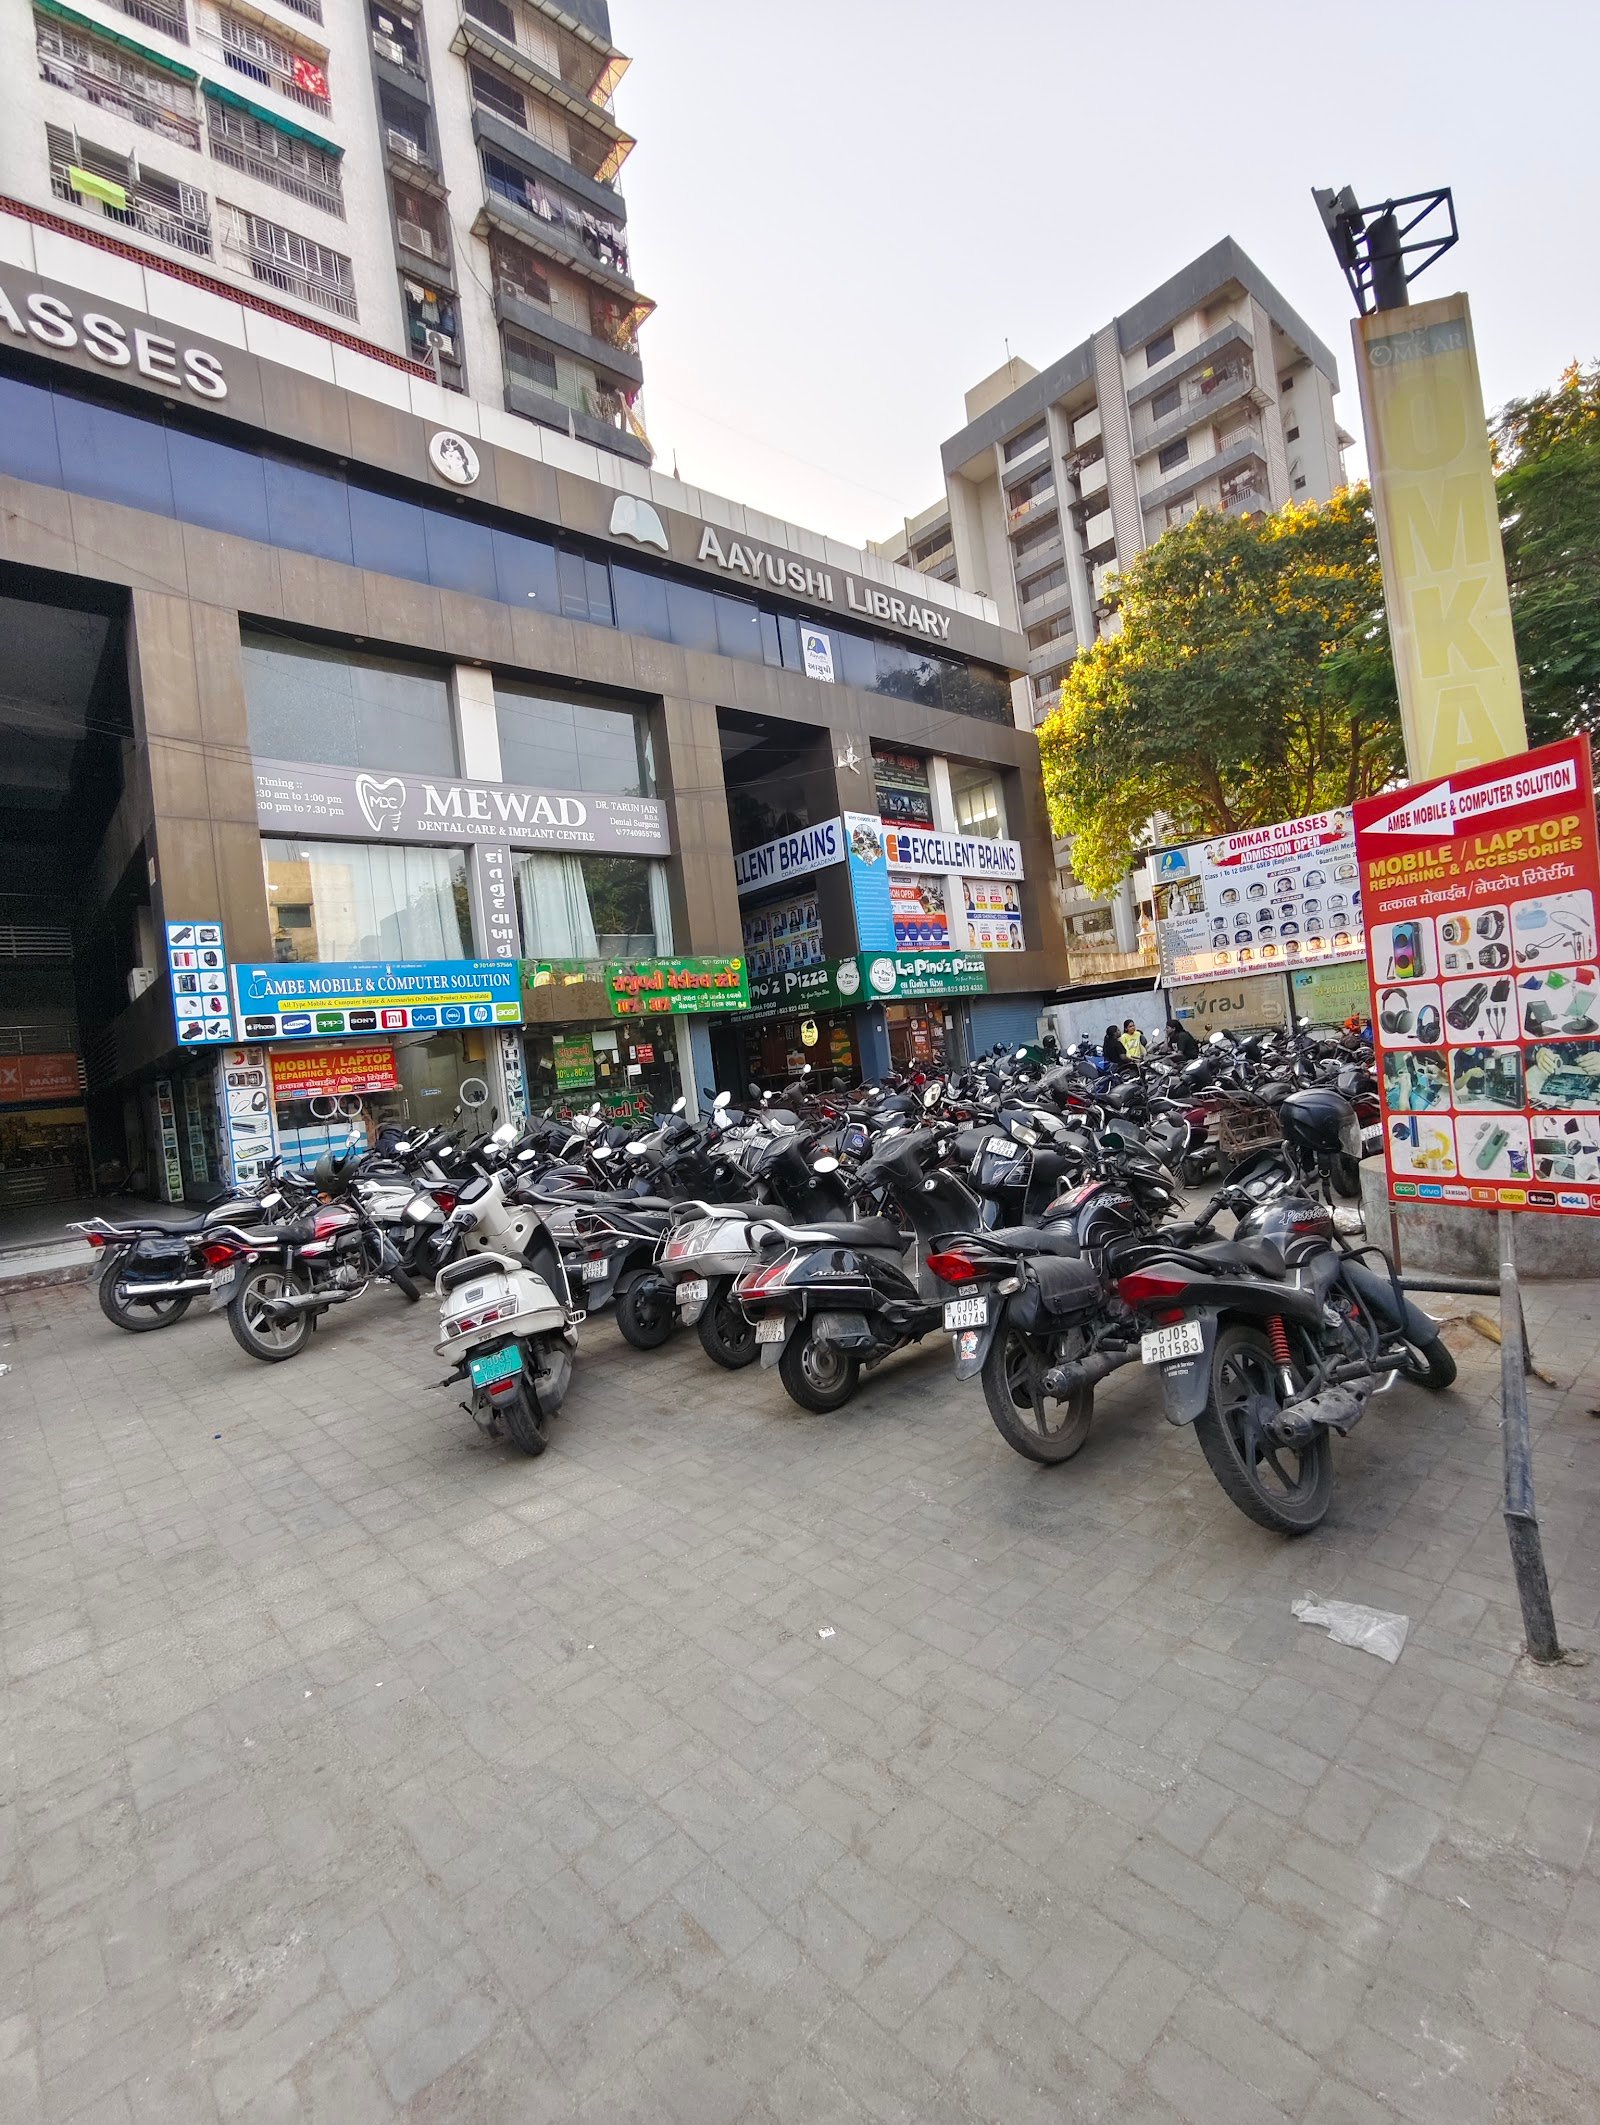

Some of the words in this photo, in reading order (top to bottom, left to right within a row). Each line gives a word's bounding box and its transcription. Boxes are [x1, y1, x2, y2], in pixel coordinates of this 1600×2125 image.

[845, 576, 950, 639] LIBRARY
[257, 776, 294, 790] Timing
[274, 792, 289, 800] am
[292, 792, 301, 800] to
[305, 793, 325, 802] 1:00
[327, 796, 342, 804] pm
[370, 796, 397, 809] MDC
[422, 784, 587, 827] MEWAD
[1387, 813, 1412, 832] AMBE
[1412, 801, 1447, 824] MOBILE
[1449, 800, 1457, 816] &
[1459, 783, 1514, 812] COMPUTER
[1515, 767, 1571, 796] SOLUTION
[276, 803, 292, 812] pm
[294, 805, 304, 813] to
[329, 808, 344, 816] pm
[610, 802, 640, 812] TARUN
[641, 805, 658, 814] JAIN
[417, 821, 464, 833] DENTAL
[467, 824, 497, 835] CARE
[499, 827, 506, 836] &
[509, 827, 555, 839] IMPLANT
[556, 830, 595, 842] CENTRE
[610, 817, 632, 827] Dental
[634, 820, 660, 829] Surgeon
[1229, 831, 1270, 851] OMKAR
[1274, 815, 1328, 840] CLASSES
[778, 825, 836, 871] BRAINS
[912, 838, 975, 868] EXCELLENT
[978, 844, 1016, 871] BRAINS
[1240, 843, 1291, 864] ADMISSION
[1294, 835, 1321, 852] OPEN
[1369, 845, 1452, 879] MOBILE
[1475, 815, 1581, 856] LAPTOP
[781, 865, 808, 878] COACHING
[809, 856, 837, 870] ACADEMY
[1205, 872, 1219, 881] Class
[1256, 861, 1271, 869] GSEB
[1315, 845, 1339, 856] Gujarati
[1319, 857, 1333, 865] Board
[1334, 854, 1351, 862] Results
[1369, 866, 1445, 892] REPAIRING
[1449, 863, 1460, 875] &
[1465, 836, 1583, 873] ACCESSORIES
[901, 889, 915, 899] OPEN
[1166, 921, 1175, 929] Our
[1176, 917, 1198, 927] Services
[895, 959, 914, 976] La
[952, 958, 985, 976] Pizza
[264, 979, 306, 996] AMBE
[308, 977, 363, 994] MOBILE
[366, 977, 375, 991] &
[377, 974, 449, 991] COMPUTER
[451, 973, 511, 988] SOLUTION
[784, 969, 828, 995] Pizza
[334, 999, 361, 1007] Computer
[763, 1001, 777, 1010] FOOD
[476, 1008, 486, 1020] hp
[274, 1058, 328, 1072] MOBILE
[340, 1053, 391, 1066] LAPTOP
[274, 1069, 323, 1080] REPAIRING
[325, 1068, 333, 1076] &
[335, 1064, 393, 1075] ACCESSORIES
[1396, 1185, 1415, 1193] oppo
[1421, 1188, 1440, 1196] vivo
[1445, 1189, 1468, 1197] SAMSUNG
[1500, 1193, 1524, 1201] realme
[1537, 1196, 1554, 1204] iPhone
[1561, 1195, 1586, 1205] DELL
[957, 1299, 979, 1313] GJ05
[952, 1311, 985, 1328] KA9749
[1158, 1325, 1188, 1344] GJ05
[1152, 1338, 1199, 1360] PR1583
